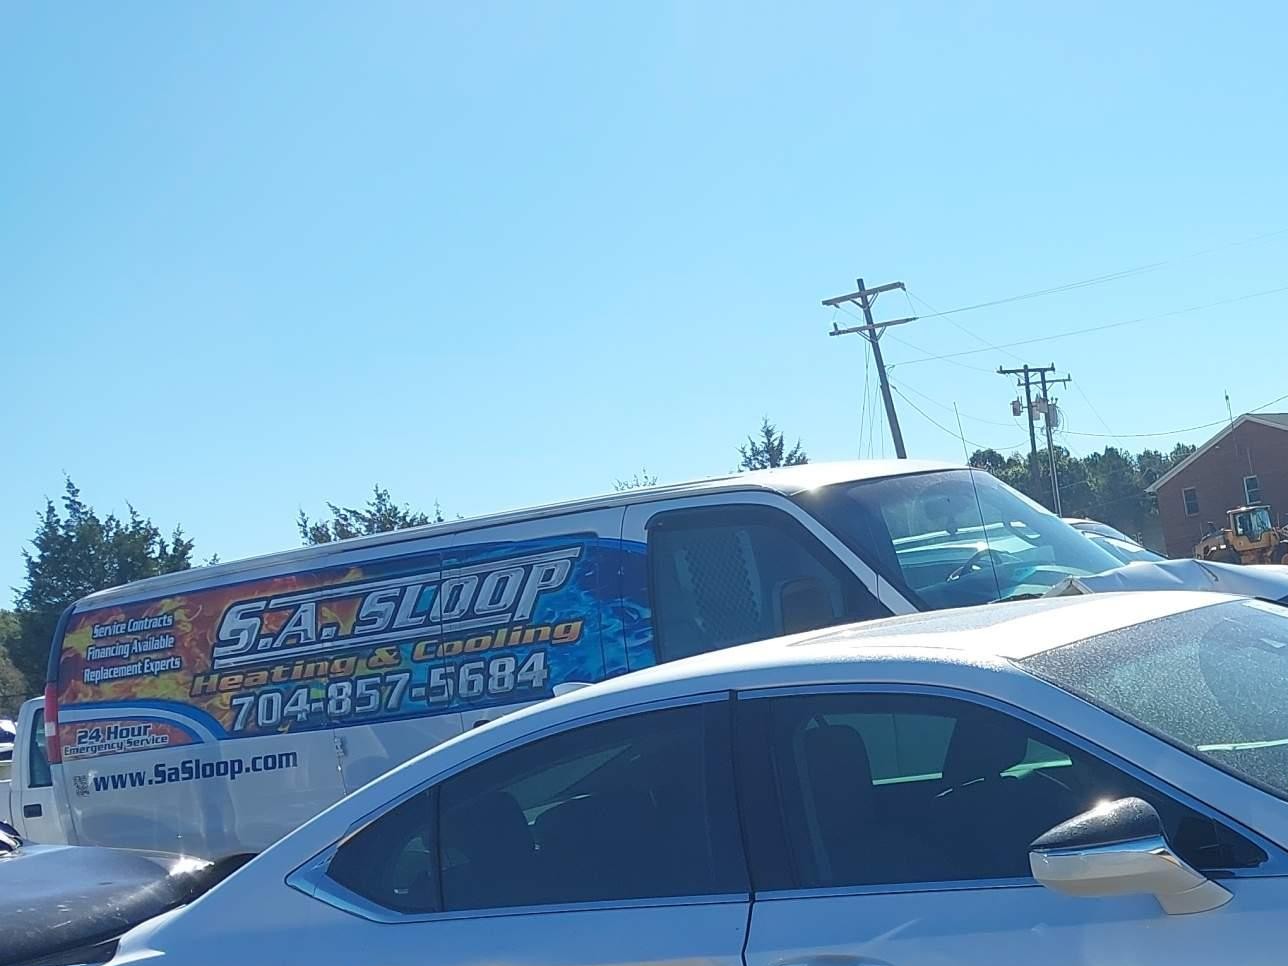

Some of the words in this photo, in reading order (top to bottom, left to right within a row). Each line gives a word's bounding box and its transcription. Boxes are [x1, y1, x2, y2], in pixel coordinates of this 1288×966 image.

[93, 623, 126, 639] Service
[127, 614, 173, 632] Contracts
[87, 645, 130, 661] Financing
[131, 635, 175, 653] Available
[191, 654, 359, 698] Heating
[368, 645, 400, 668] &
[411, 619, 585, 661] Cooling
[84, 662, 142, 684] Replacement
[144, 656, 181, 675] Experts
[231, 652, 549, 732] 704-857-5684
[64, 741, 125, 756] Emergency
[126, 734, 168, 748] Service
[77, 729, 102, 745] 24
[105, 724, 152, 741] Hour
[94, 752, 298, 792] www.SaSloop.com
